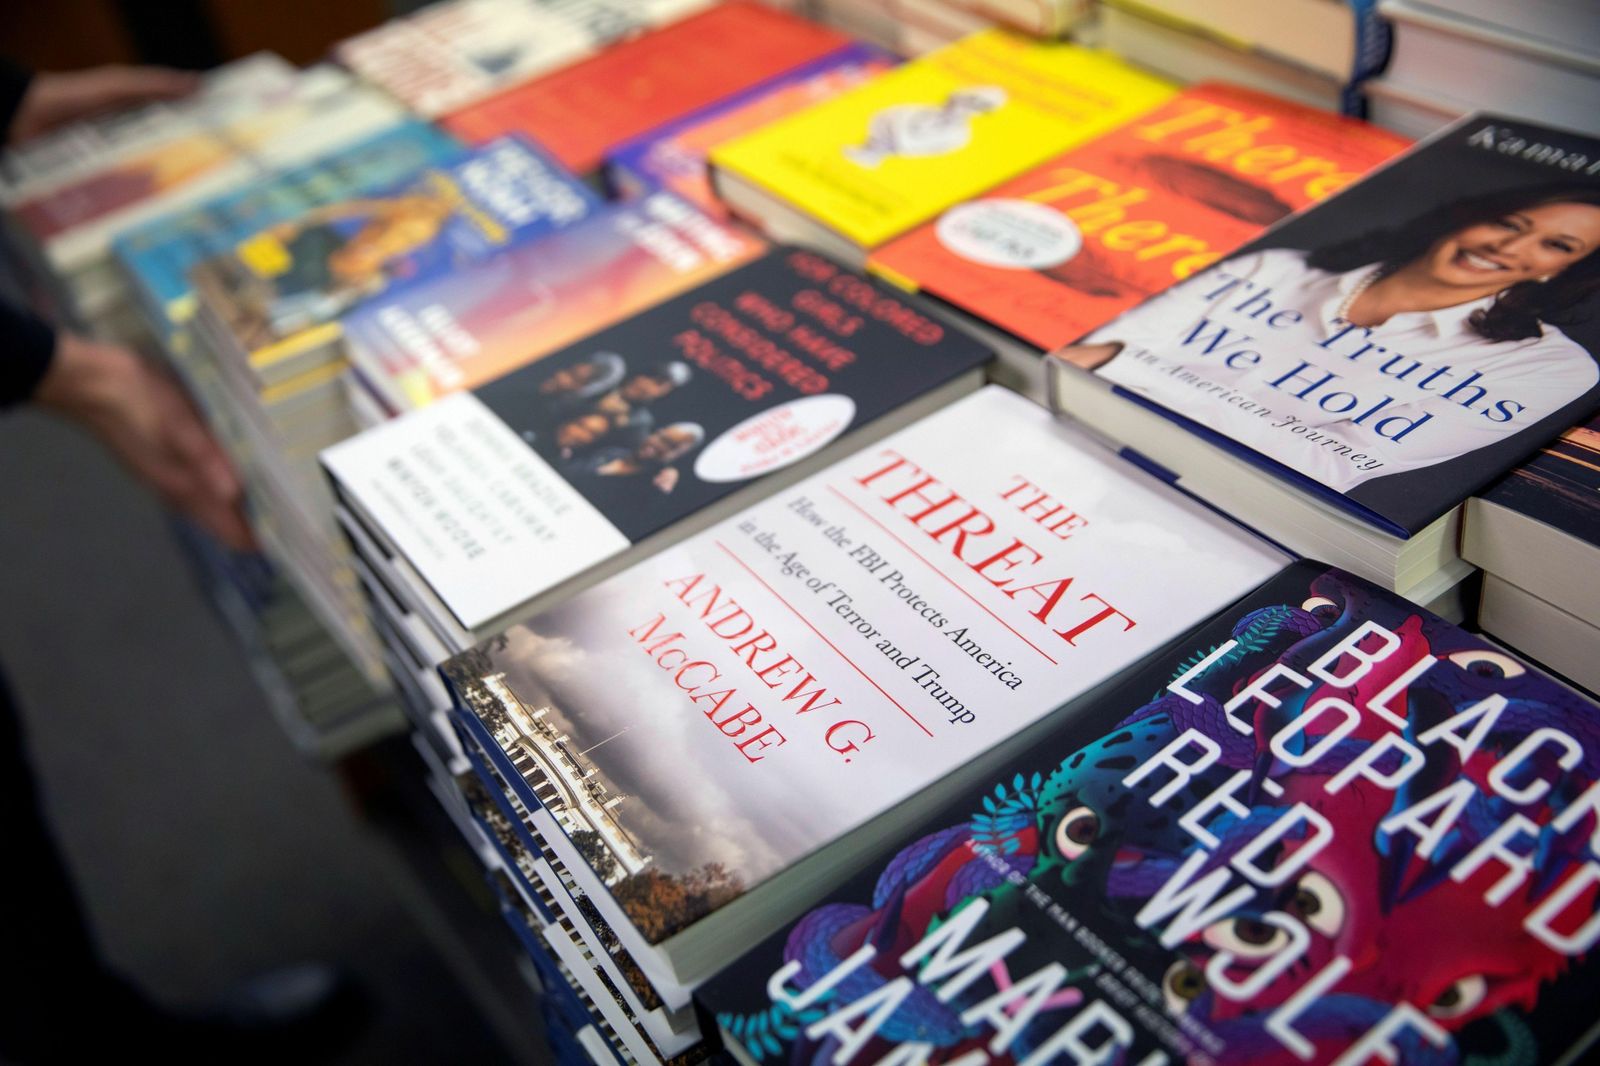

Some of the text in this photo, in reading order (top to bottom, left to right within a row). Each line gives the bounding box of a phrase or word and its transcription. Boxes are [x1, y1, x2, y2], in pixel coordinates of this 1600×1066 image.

[1133, 99, 1362, 202] There
[1127, 348, 1385, 472] An American Journey
[1181, 318, 1434, 445] We Hold
[1202, 272, 1526, 423] The Truths
[854, 449, 1137, 647] THREAT
[998, 474, 1089, 540] THE
[662, 572, 877, 764] ANDREW G.
[737, 517, 976, 724] in the Age of Terror and Trump
[788, 496, 1024, 691] How the FBI Protects America
[626, 611, 788, 764] McCABE
[1121, 727, 1335, 887] RED
[963, 838, 1011, 877] AUTHOR
[1024, 882, 1053, 910] THE
[1045, 901, 1080, 933] MAN
[1073, 925, 1127, 974] BOOKER
[1134, 848, 1450, 1066] WOLF
